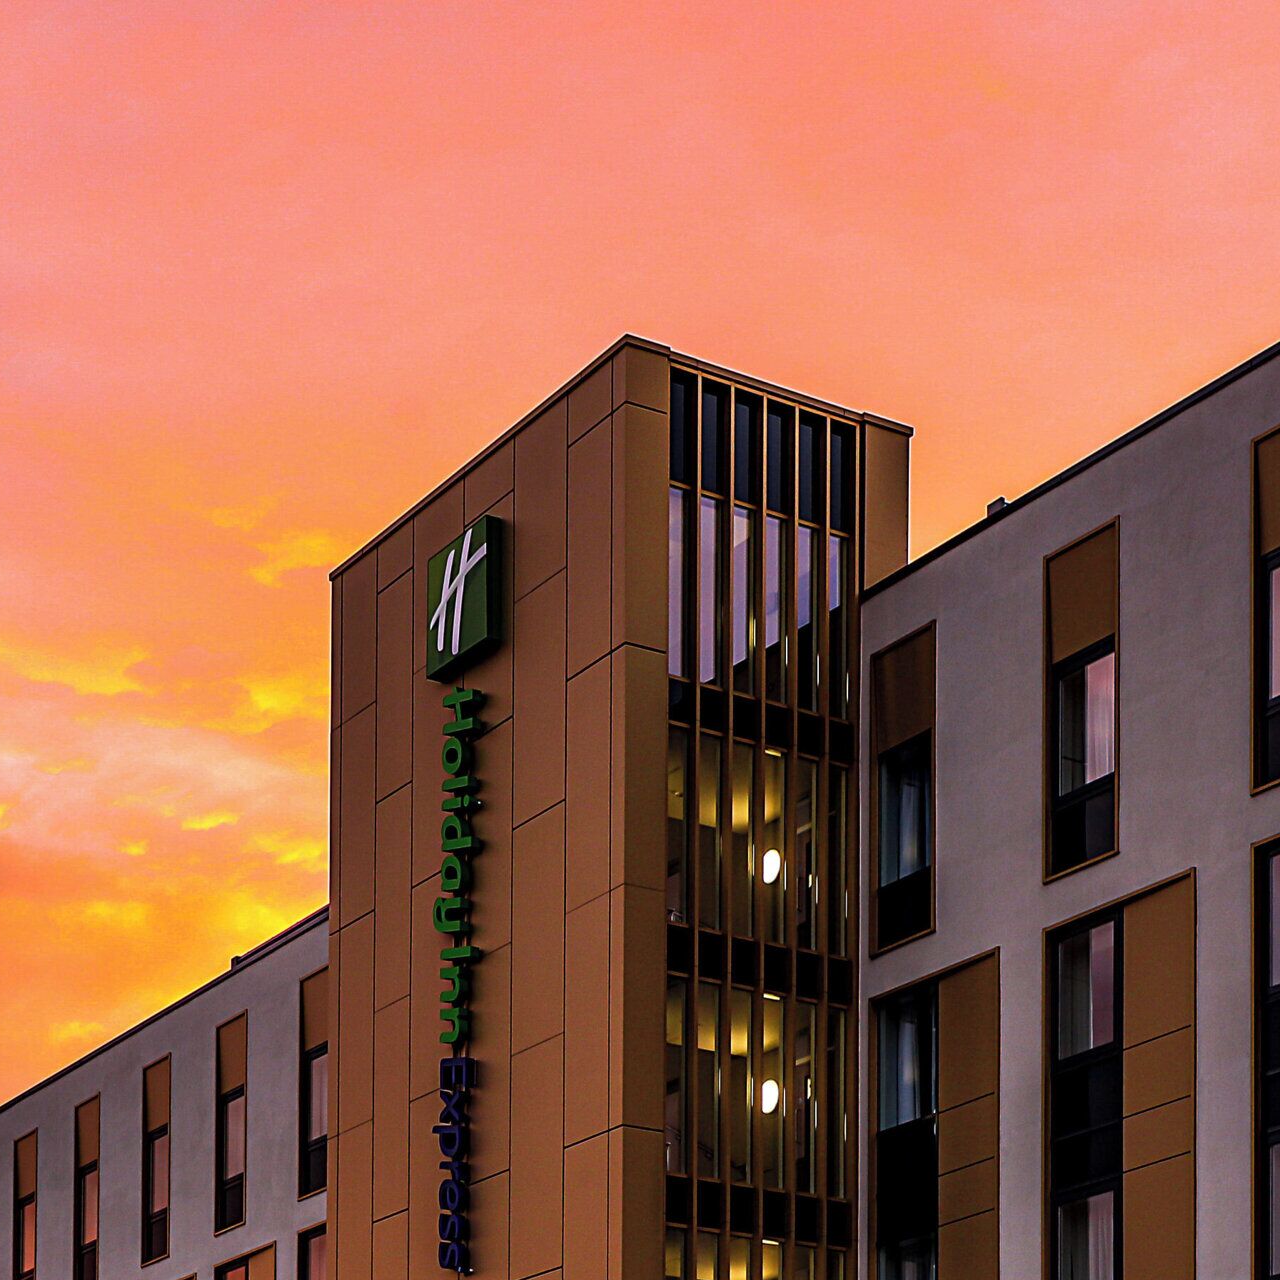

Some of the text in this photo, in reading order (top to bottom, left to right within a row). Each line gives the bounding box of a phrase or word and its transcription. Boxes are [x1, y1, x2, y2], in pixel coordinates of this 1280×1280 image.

[431, 686, 478, 1270] Holiday Inn Express
